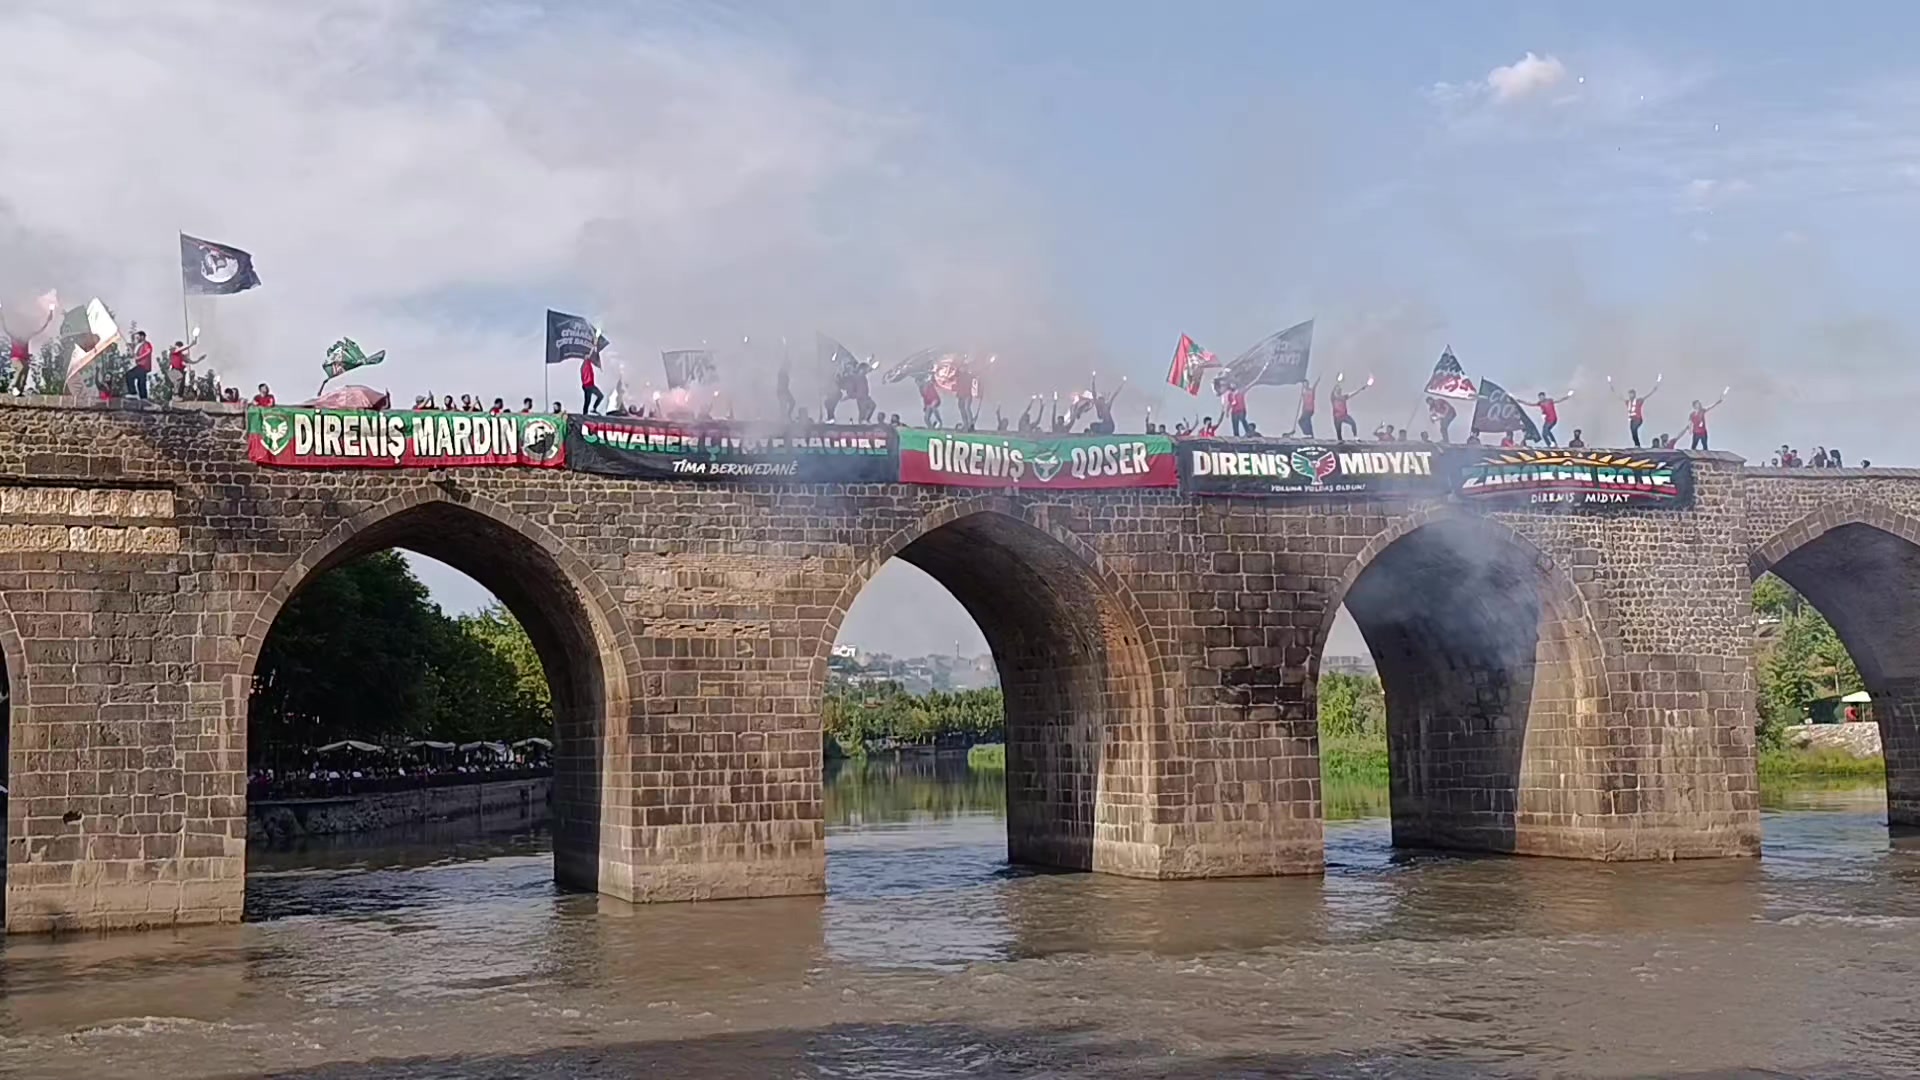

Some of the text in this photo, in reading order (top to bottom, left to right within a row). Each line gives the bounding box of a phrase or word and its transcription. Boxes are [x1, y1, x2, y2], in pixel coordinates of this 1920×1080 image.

[294, 409, 406, 463] DİRENİŞ
[927, 434, 1151, 482] DİRENİŞ QOSER
